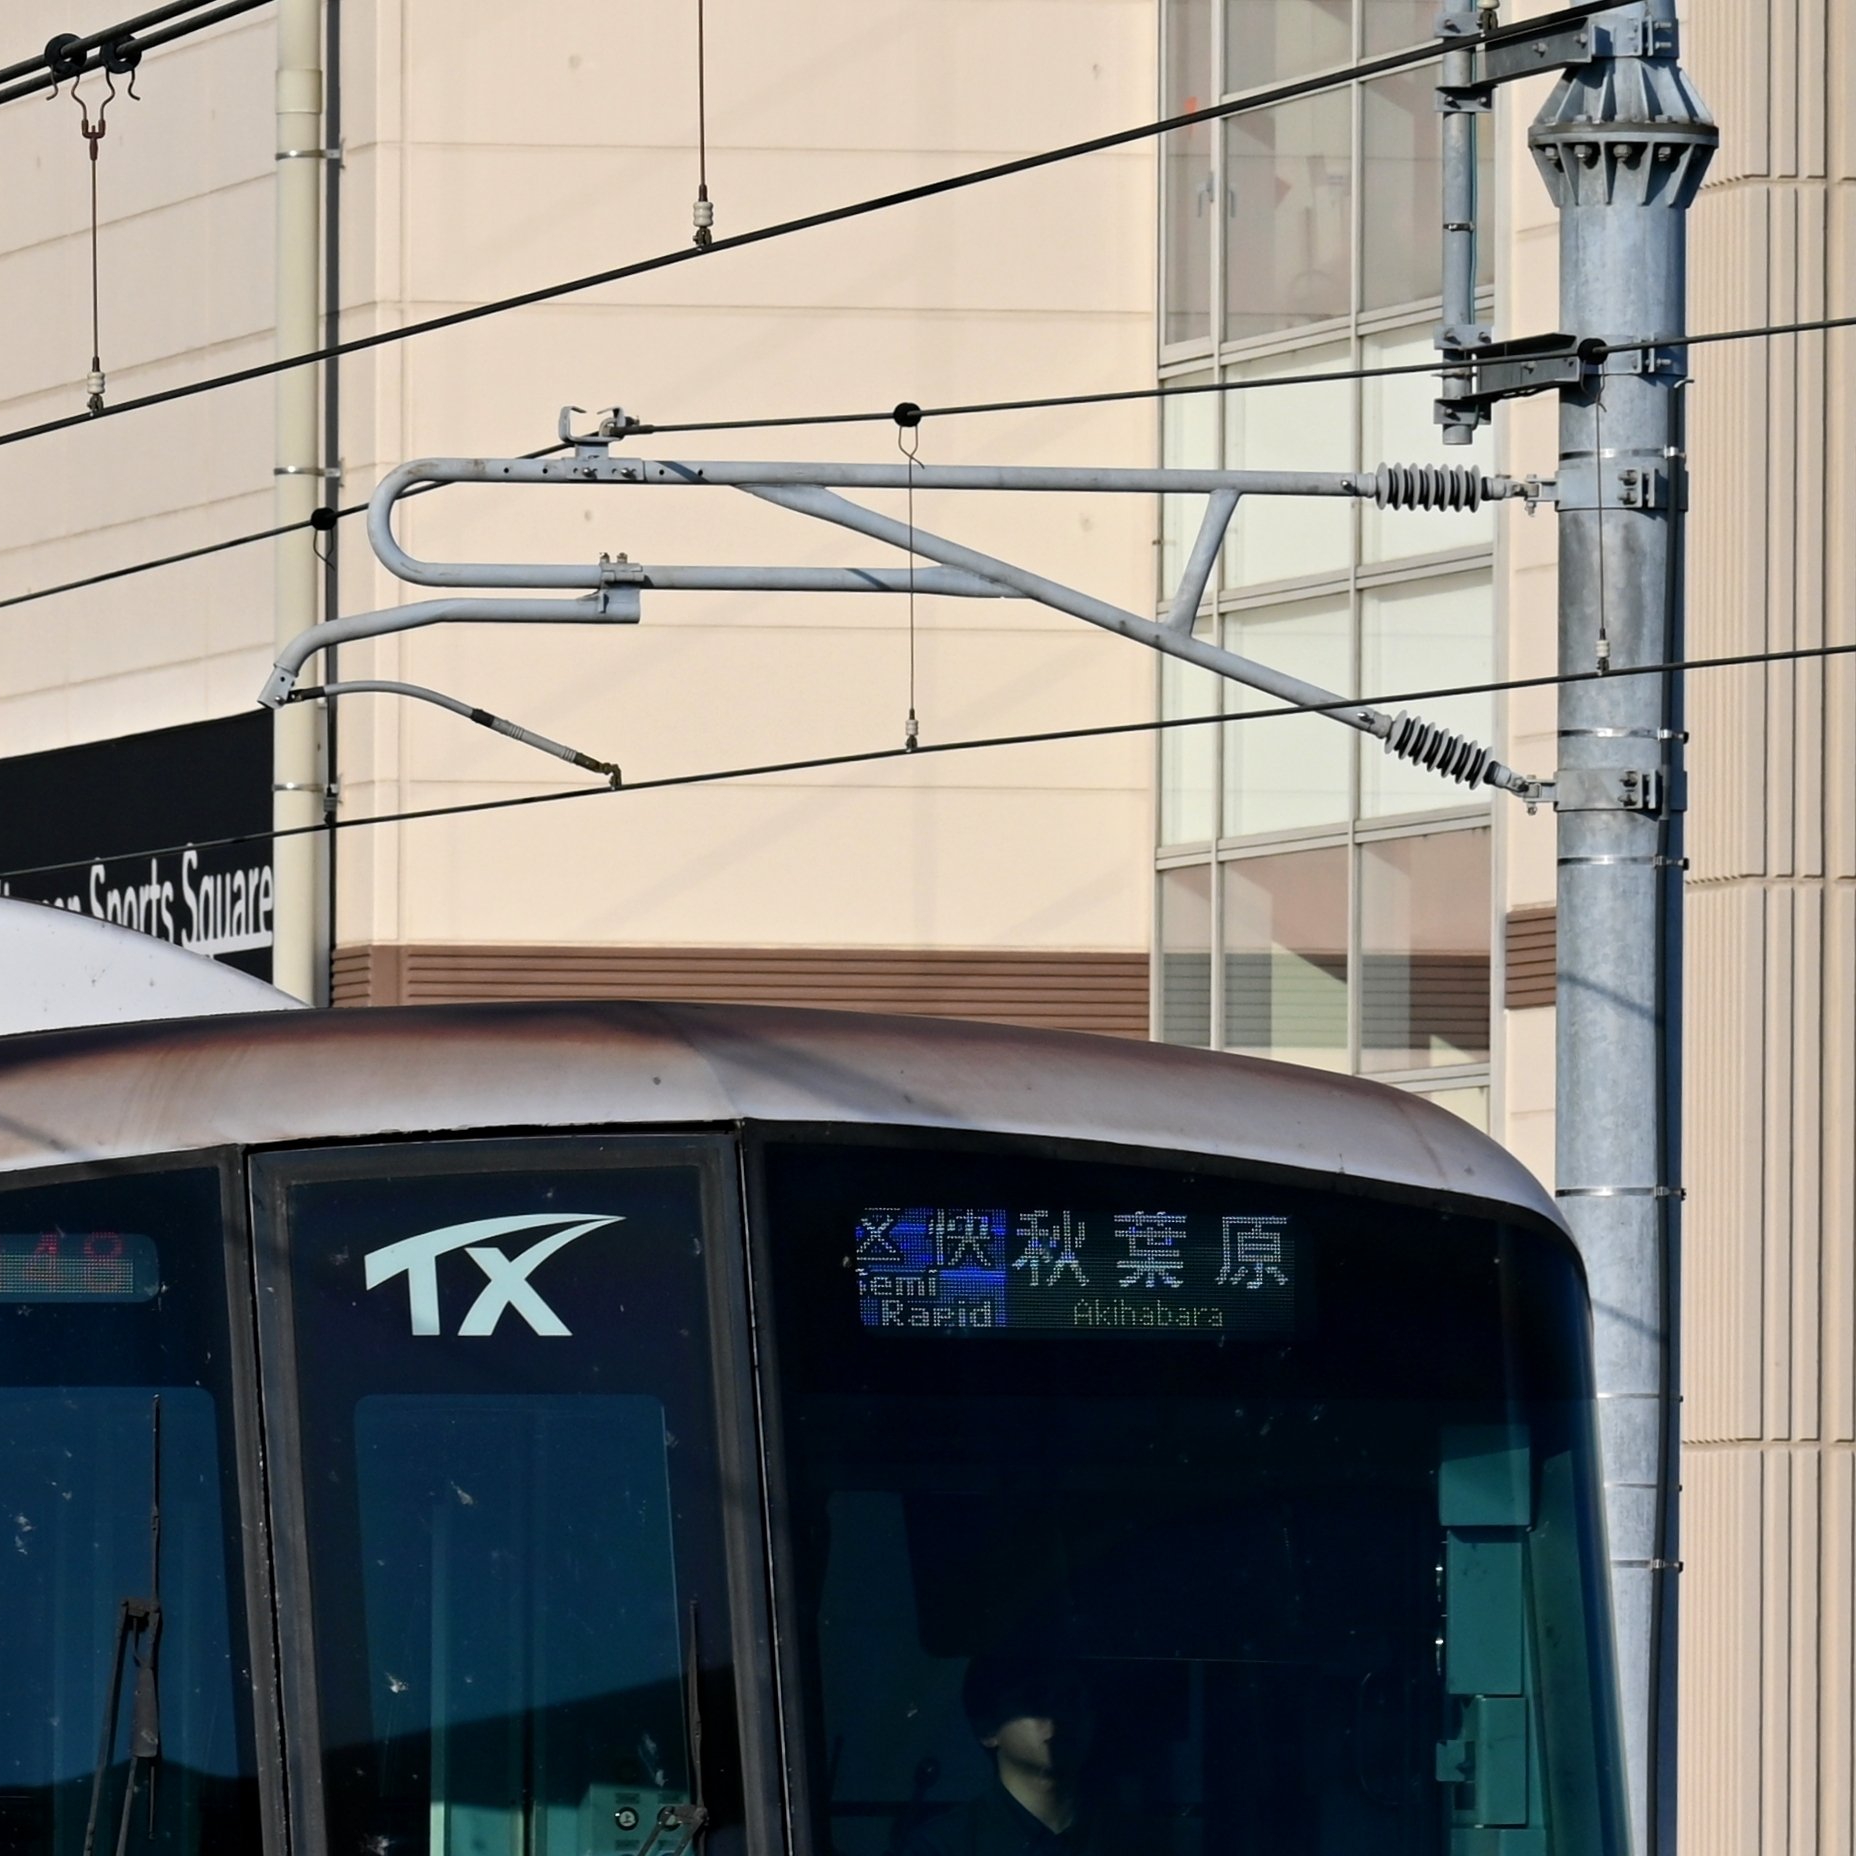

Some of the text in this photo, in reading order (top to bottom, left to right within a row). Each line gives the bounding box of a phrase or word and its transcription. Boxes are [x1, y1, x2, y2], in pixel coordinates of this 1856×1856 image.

[90, 843, 273, 945] Sports Square
[364, 1213, 627, 1336] TX
[1012, 1211, 1289, 1289] 秋葉原
[882, 1300, 991, 1329] Rapid
[1073, 1299, 1225, 1328] Akihabara
